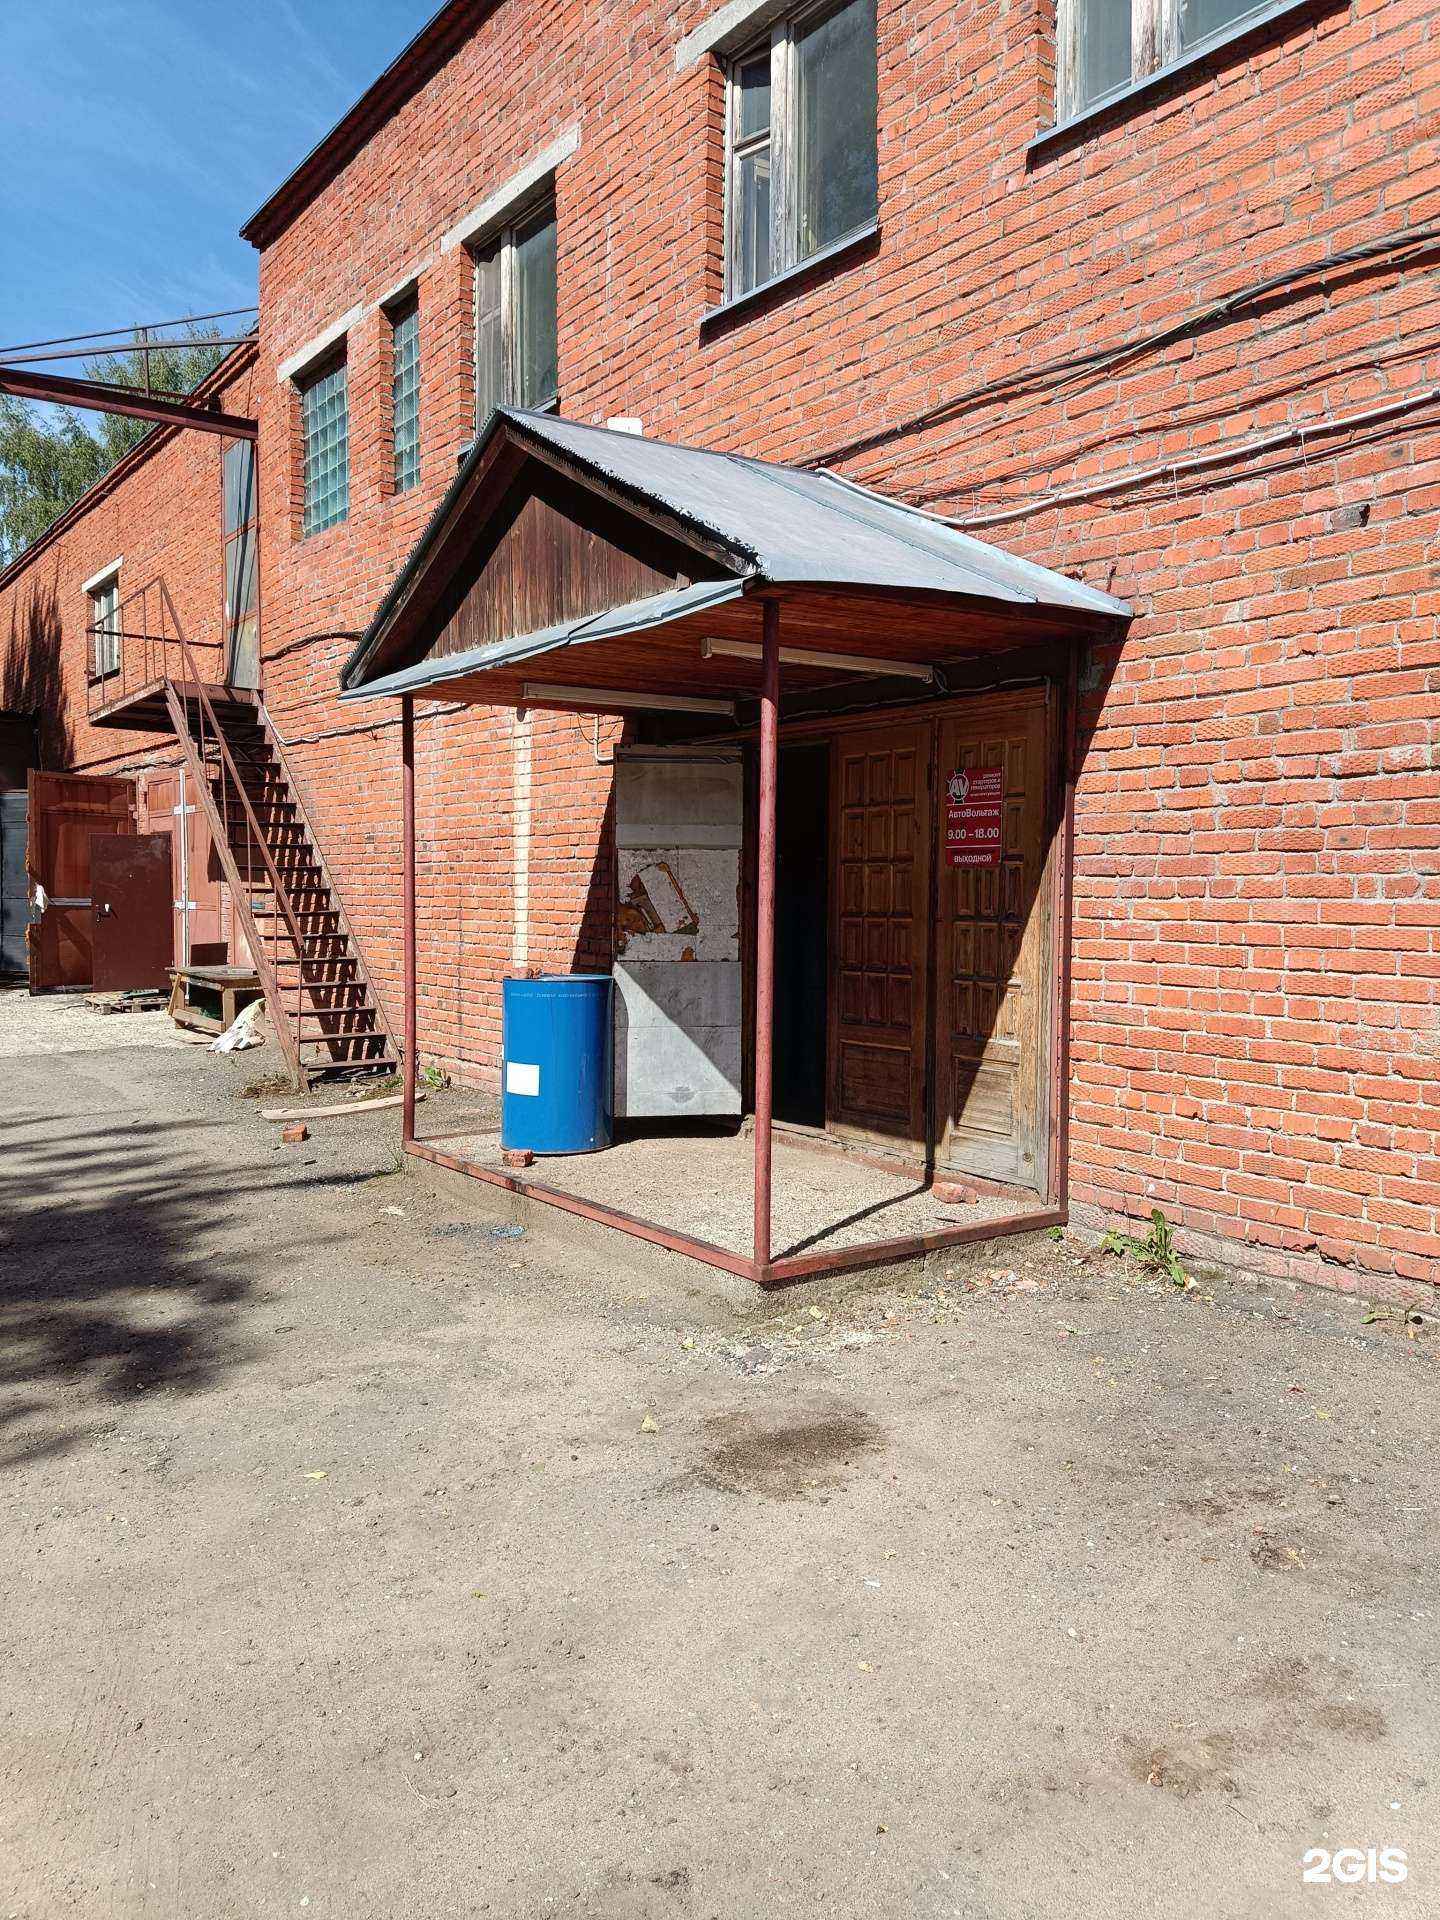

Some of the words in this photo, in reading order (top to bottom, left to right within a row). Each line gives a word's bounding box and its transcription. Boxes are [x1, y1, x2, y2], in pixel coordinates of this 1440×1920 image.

[949, 809, 1000, 819] АвтоВольтаж
[947, 829, 967, 840] 9.00
[975, 827, 1000, 839] 18.00
